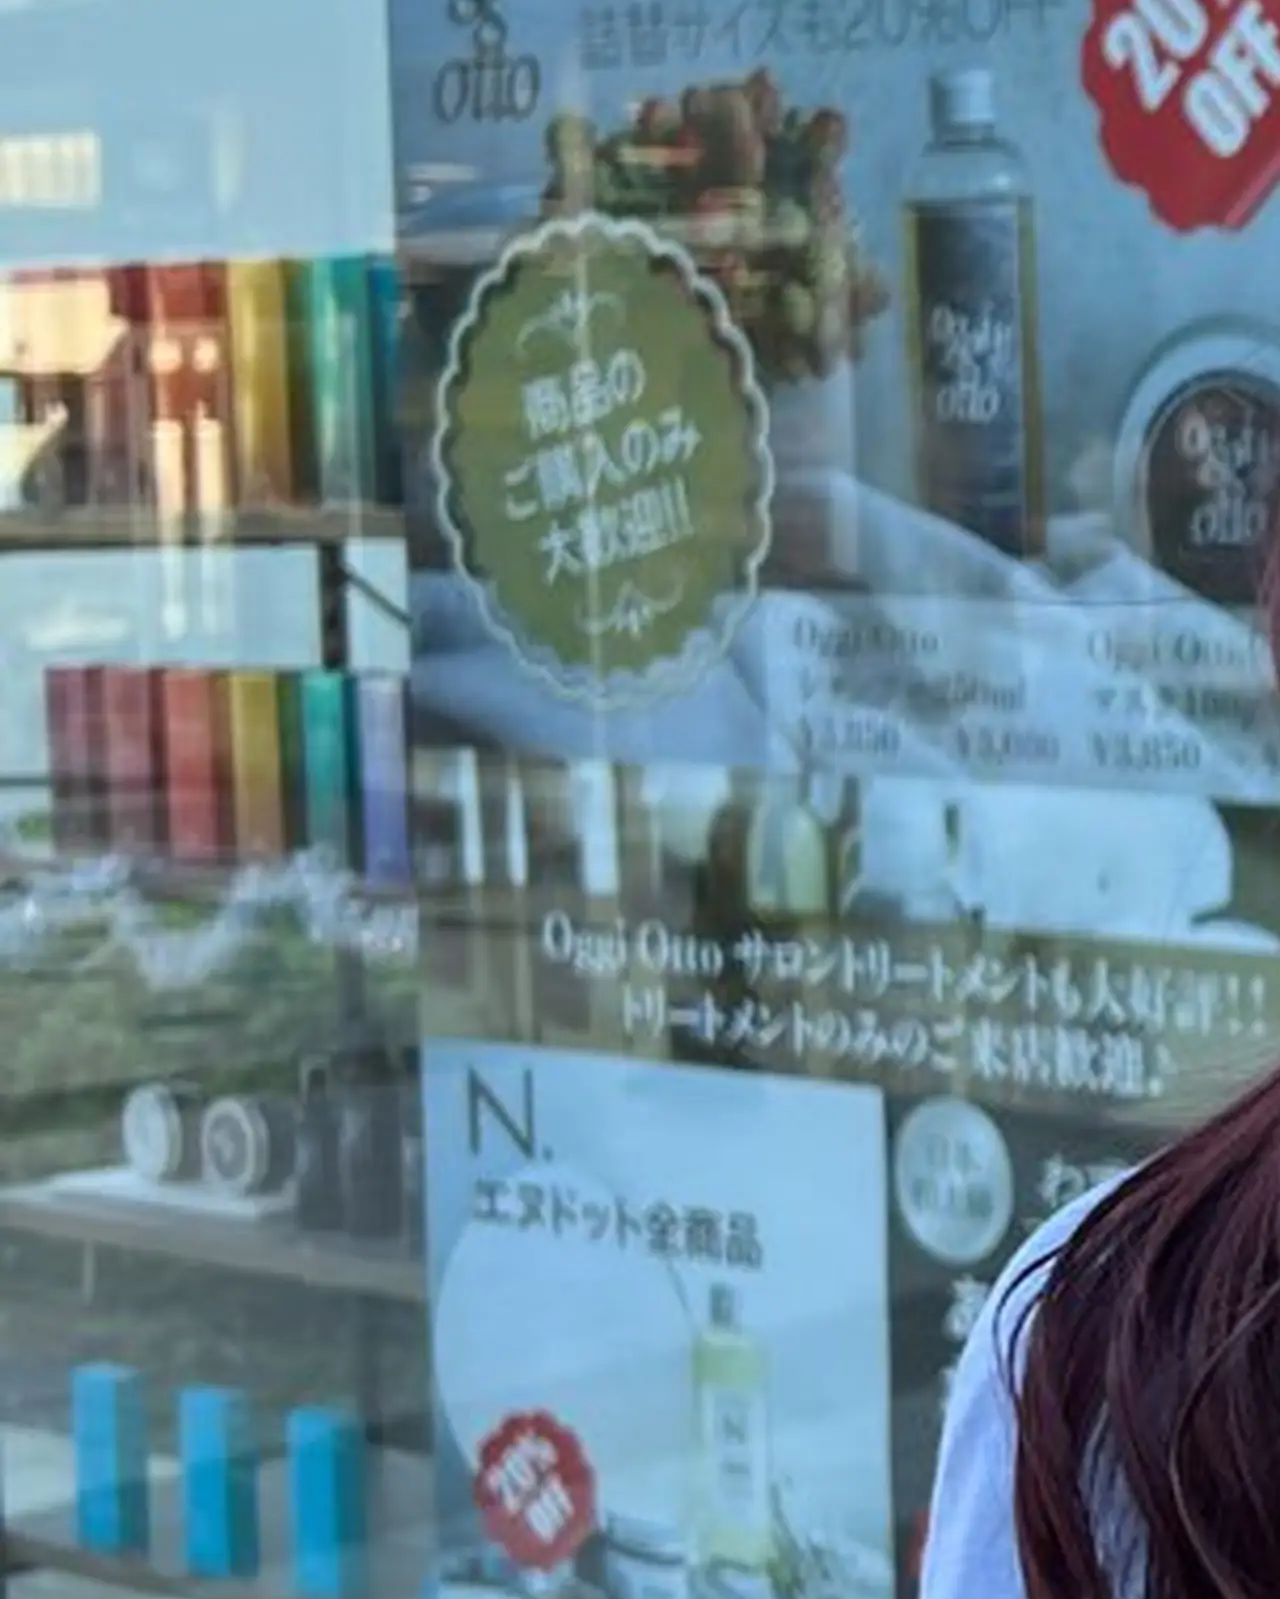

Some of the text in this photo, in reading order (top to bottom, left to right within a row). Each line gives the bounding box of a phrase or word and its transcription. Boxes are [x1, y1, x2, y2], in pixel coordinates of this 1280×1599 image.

[543, 908, 627, 978] Oggi
[637, 919, 724, 979] Otto
[472, 1178, 762, 1269] エヌドット全商品
[488, 1433, 557, 1513] 20%
[525, 1475, 575, 1544] OFF
